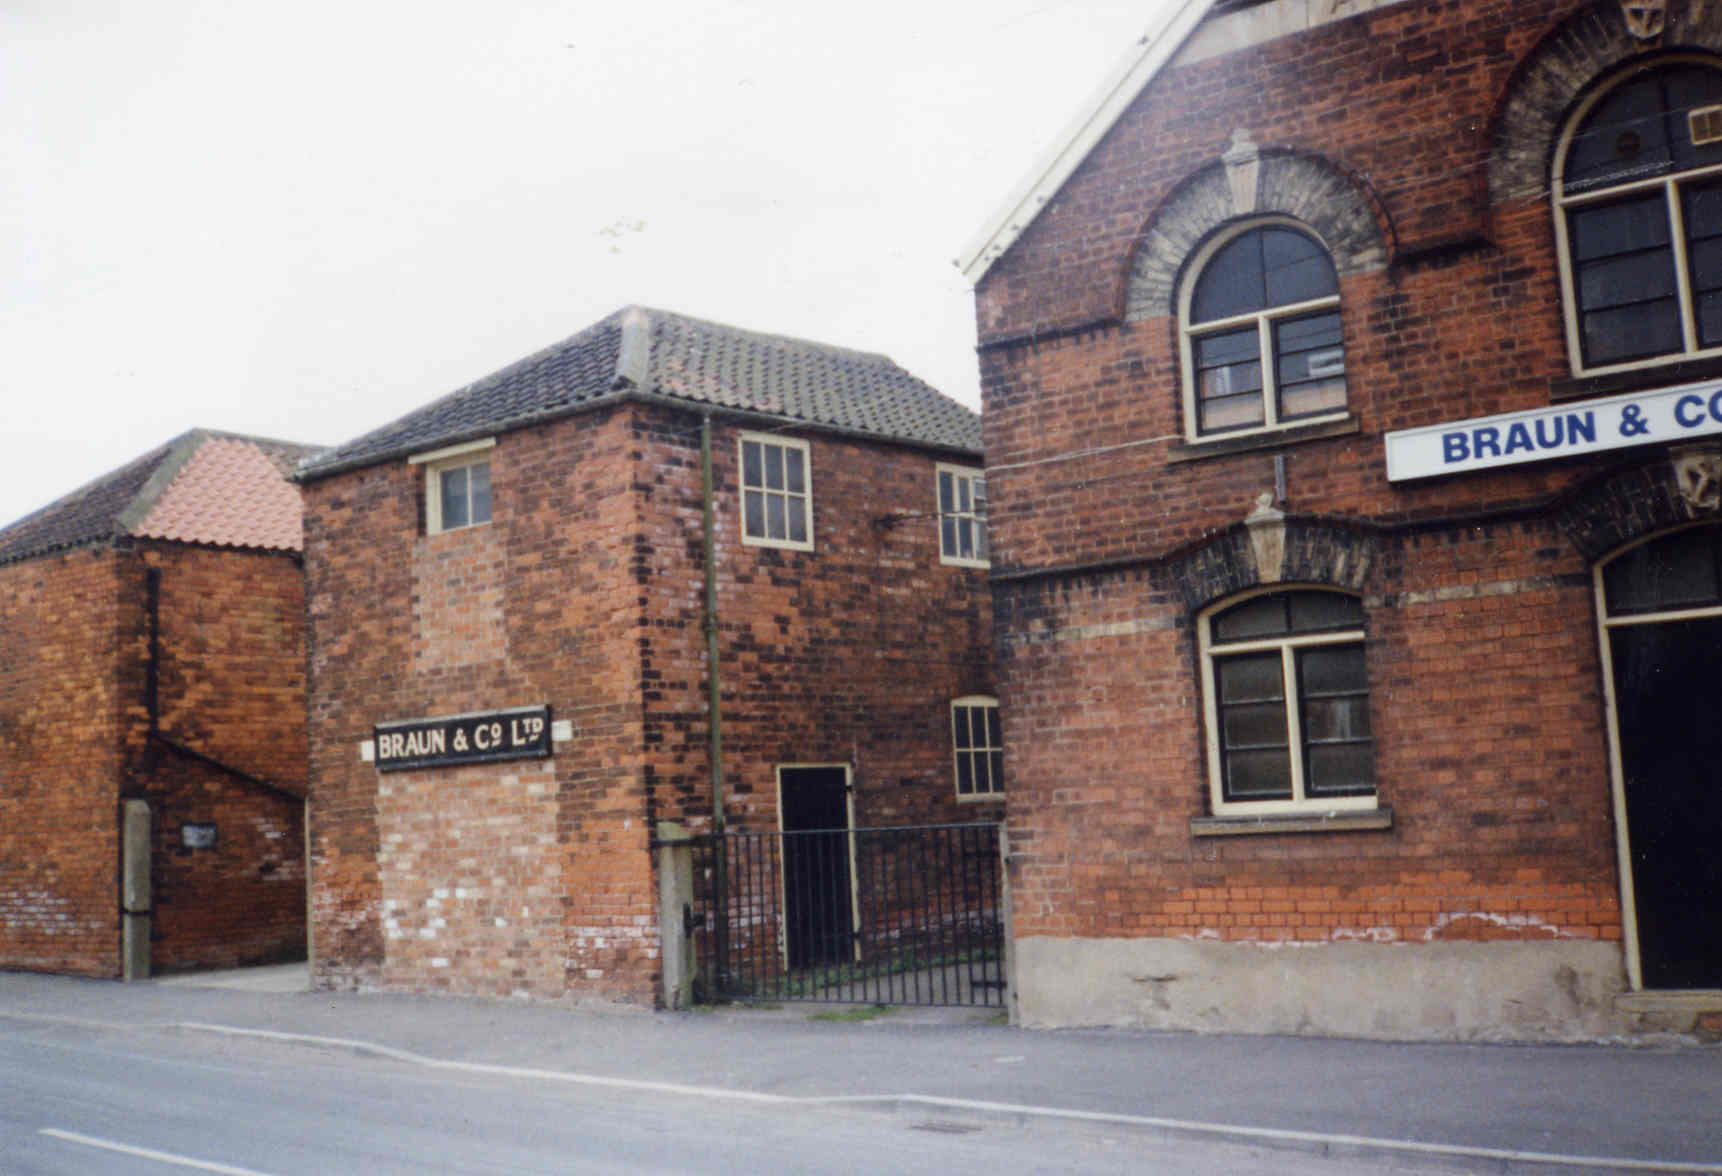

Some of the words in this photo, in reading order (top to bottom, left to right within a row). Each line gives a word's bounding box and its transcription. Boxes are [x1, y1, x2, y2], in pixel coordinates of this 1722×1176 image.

[1442, 411, 1597, 464] BRAUN
[1619, 403, 1651, 437] &
[379, 729, 446, 759] BRAUN
[453, 728, 469, 751] &
